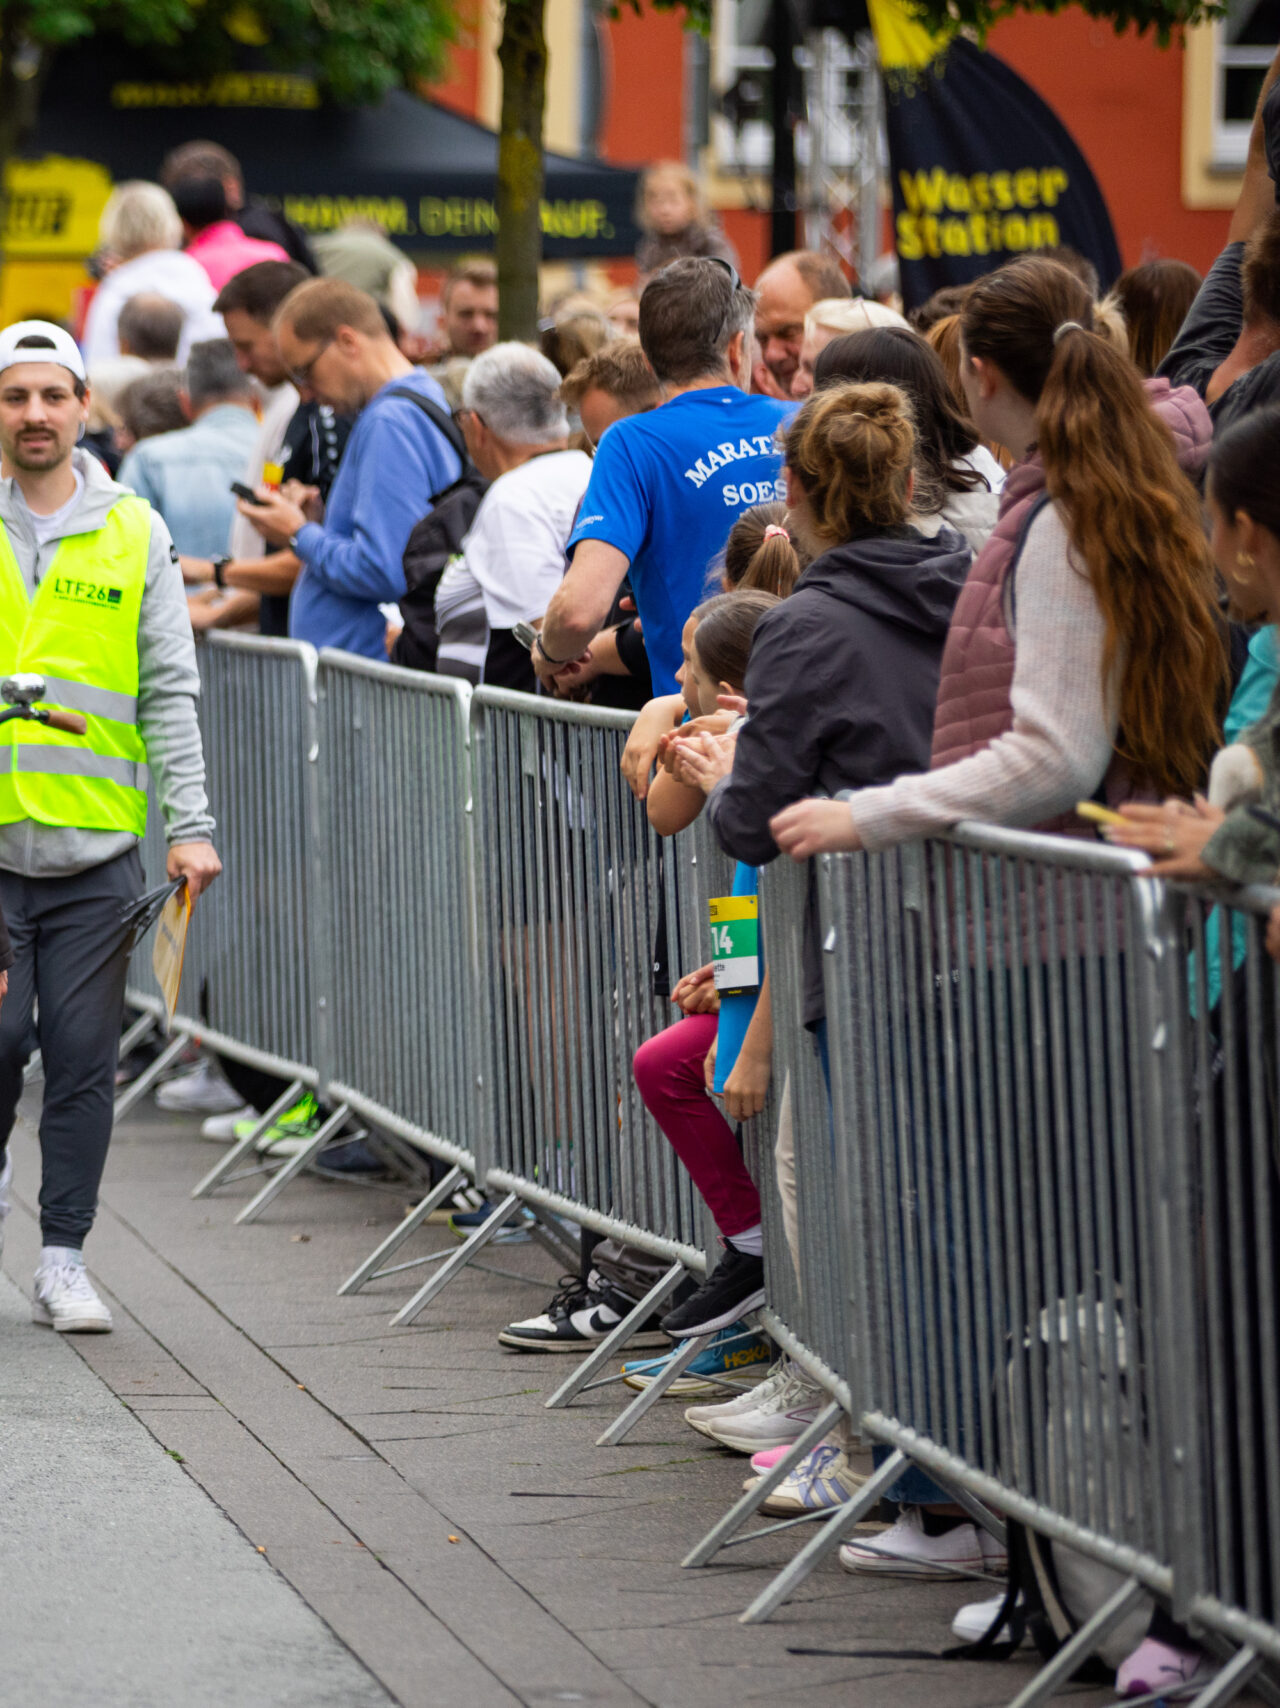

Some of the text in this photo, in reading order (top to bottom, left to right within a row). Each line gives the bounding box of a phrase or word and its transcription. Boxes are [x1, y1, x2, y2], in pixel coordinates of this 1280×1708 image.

[898, 165, 1069, 214] Wasser
[539, 199, 616, 240] AUF.
[896, 211, 1061, 260] Station
[55, 578, 106, 601] LTF26
[724, 1344, 770, 1369] HOKA
